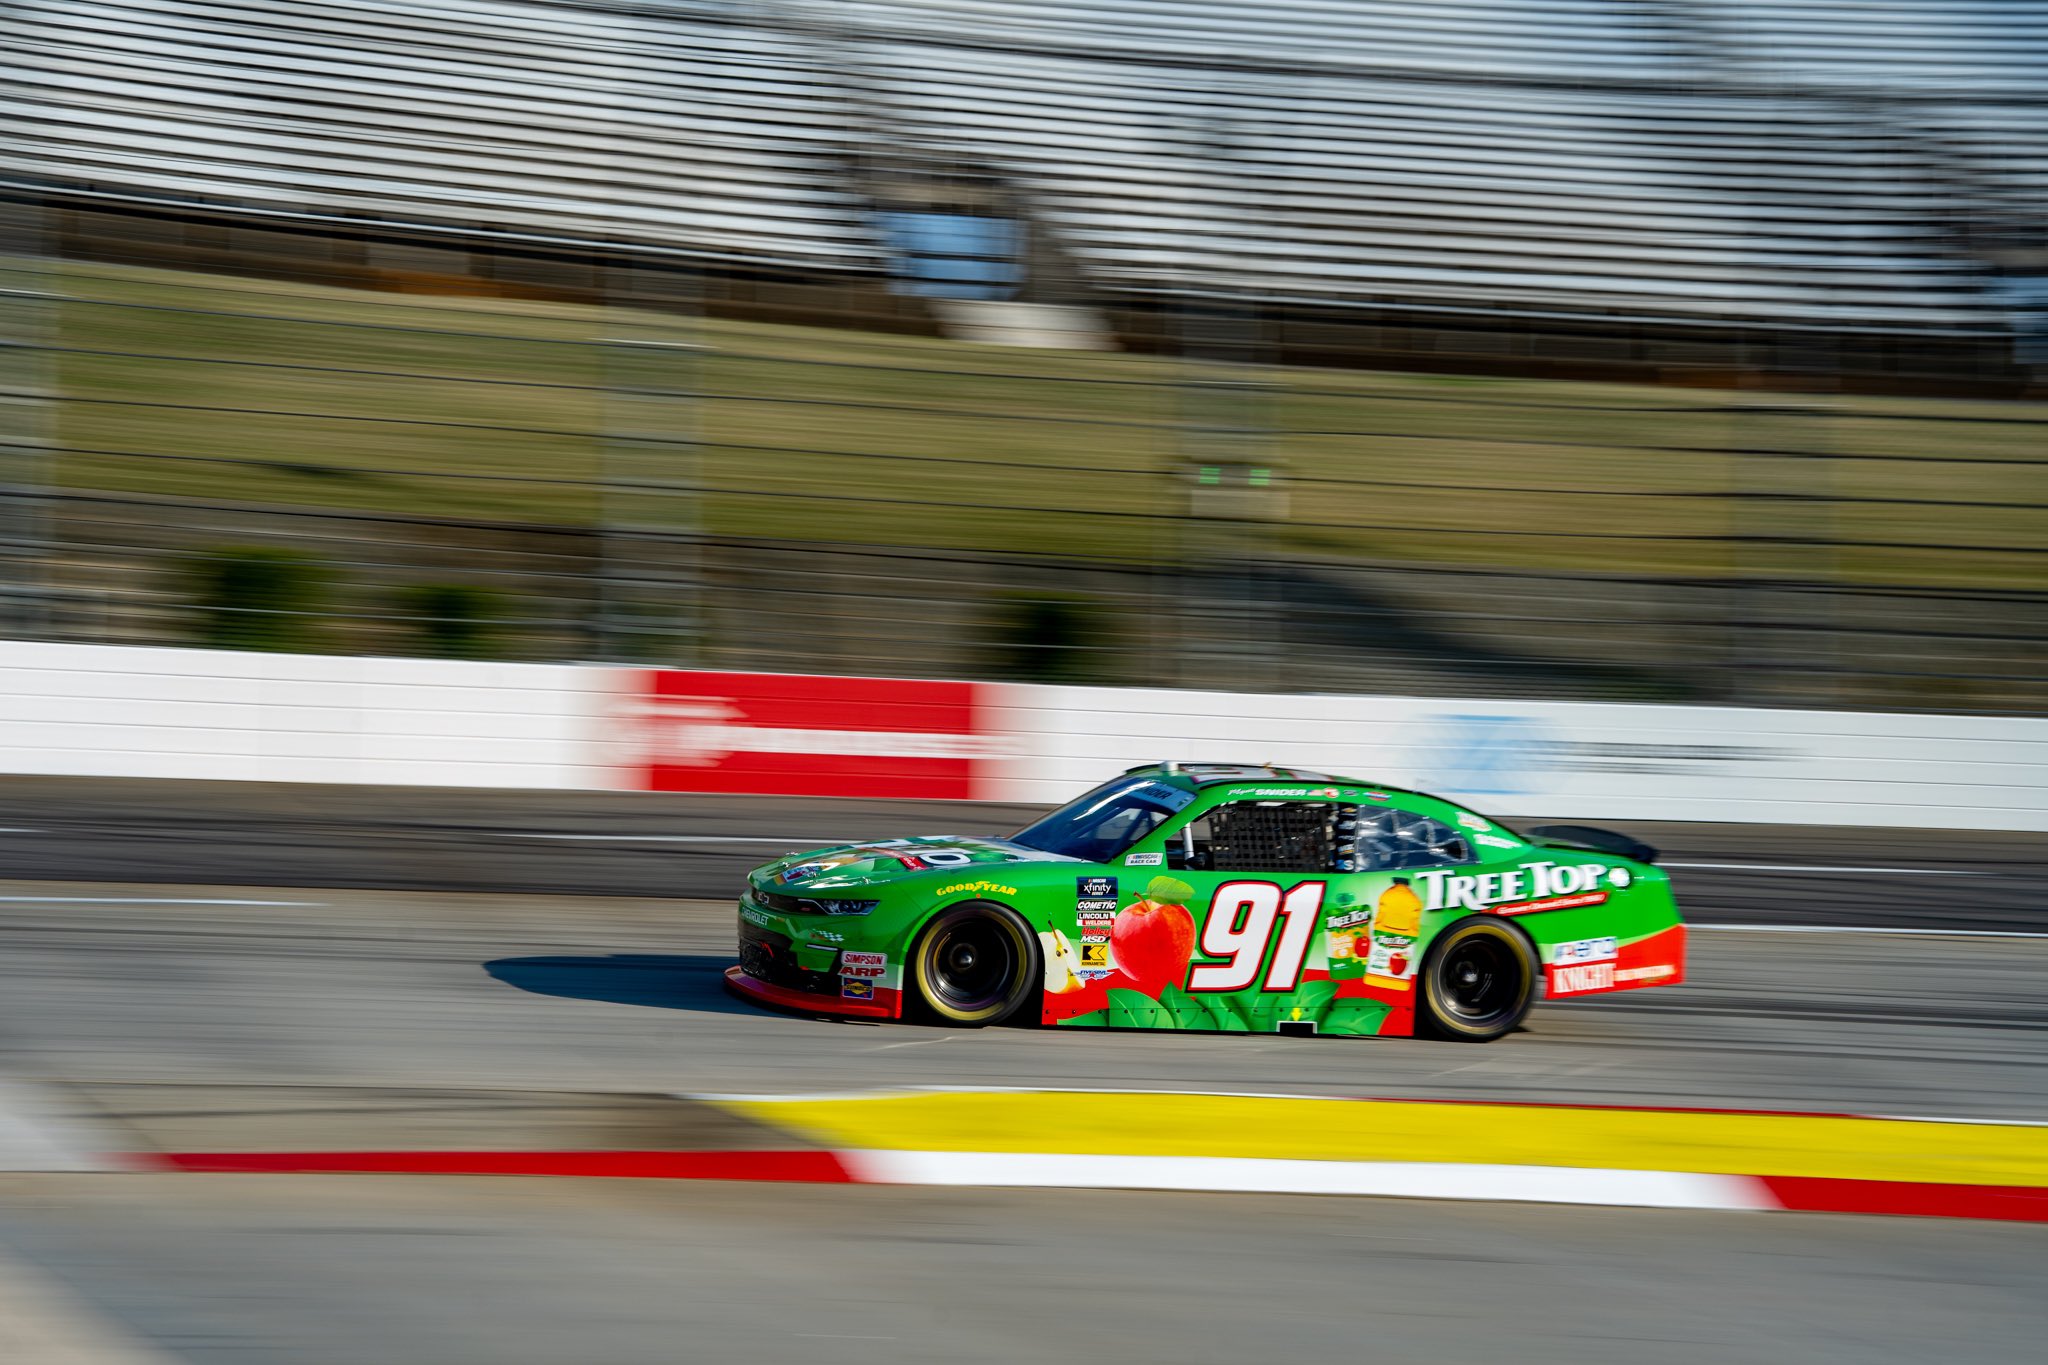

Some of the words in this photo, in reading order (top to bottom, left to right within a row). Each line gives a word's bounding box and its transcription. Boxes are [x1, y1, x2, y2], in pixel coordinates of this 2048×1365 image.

[1255, 788, 1307, 796] SNIDER
[936, 880, 1018, 897] GOODYEAR
[1083, 882, 1112, 894] xfinity
[1414, 869, 1527, 911] TREE
[1518, 860, 1607, 898] TOP
[1077, 900, 1117, 910] COMETIC
[741, 906, 769, 926] CHEVROLET
[1078, 912, 1109, 920] LINCOLN
[1081, 926, 1111, 936] Holley
[1184, 879, 1327, 993] 91
[1080, 934, 1106, 943] MSD
[844, 953, 883, 965] SIMPSON
[840, 965, 886, 977] ARP
